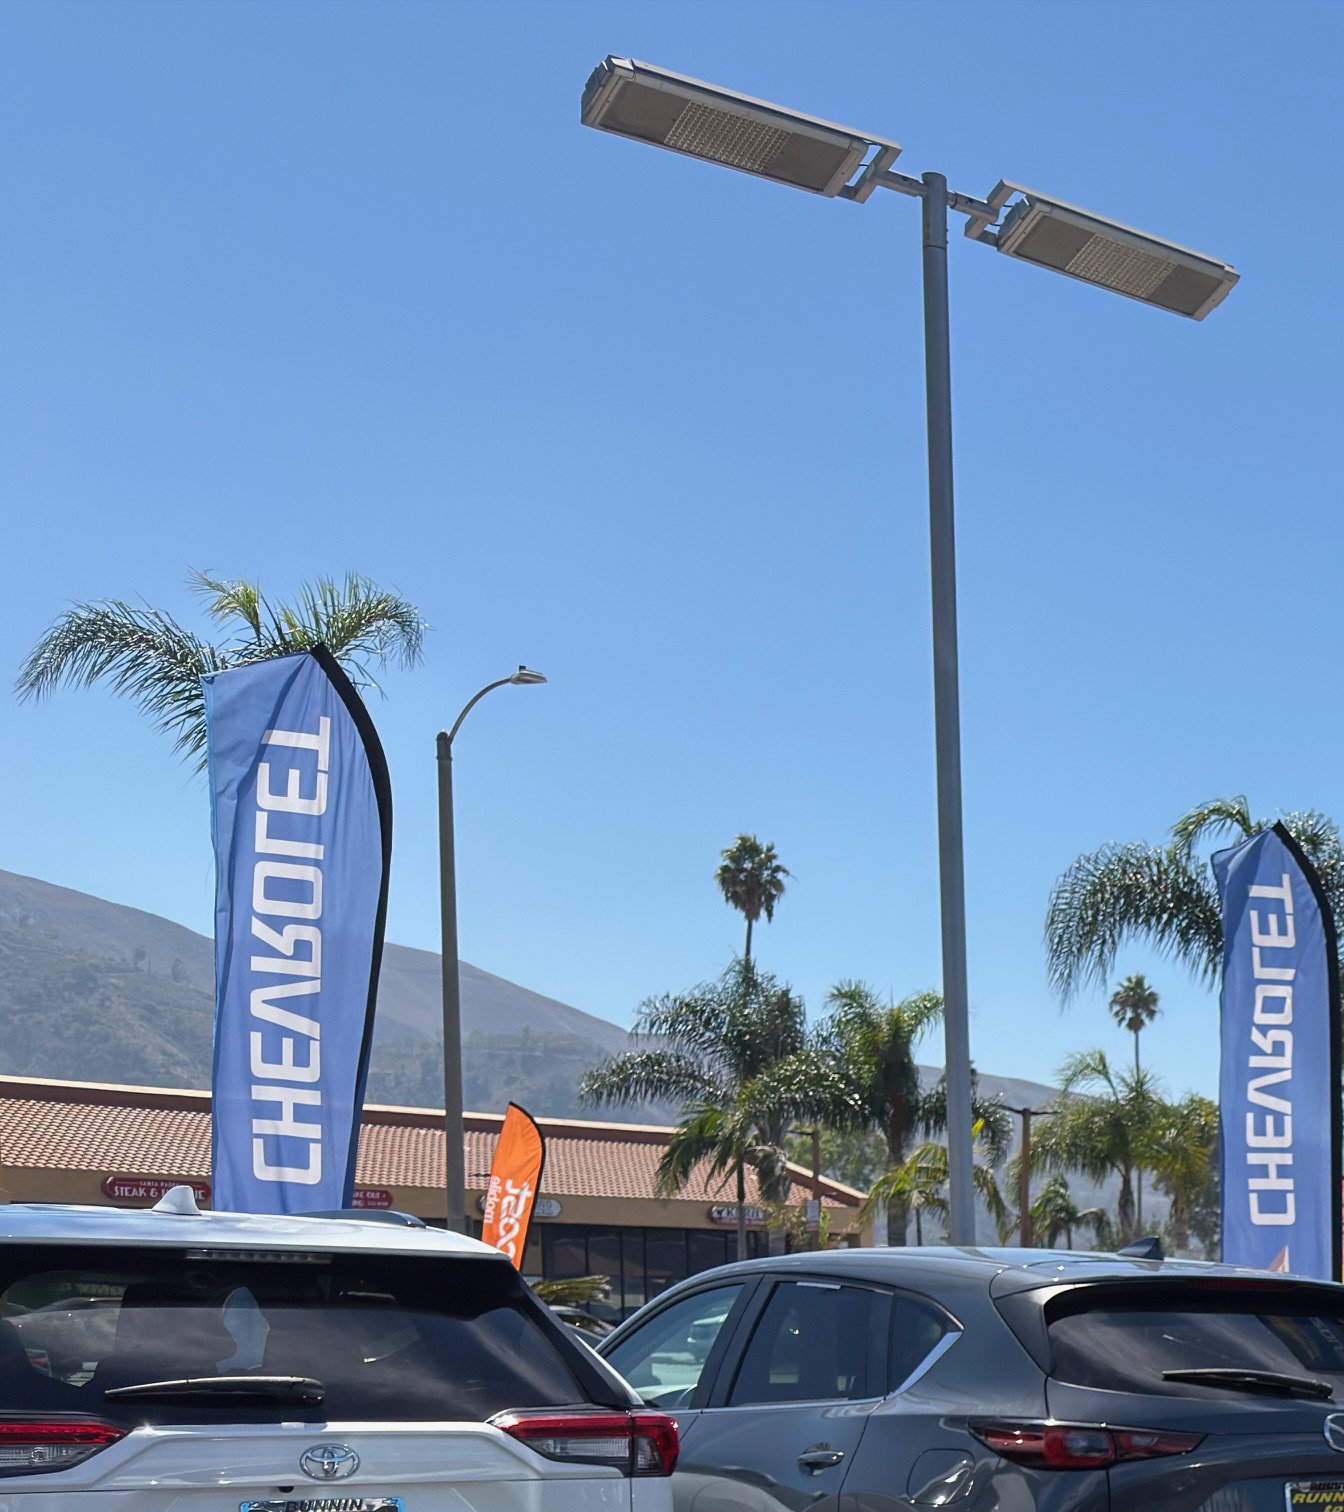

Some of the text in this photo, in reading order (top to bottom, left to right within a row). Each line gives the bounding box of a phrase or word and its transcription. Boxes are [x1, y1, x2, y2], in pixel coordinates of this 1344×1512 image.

[114, 1185, 147, 1198] STEAK
[149, 1187, 158, 1198] &
[285, 1498, 364, 1512] BUNNIN
